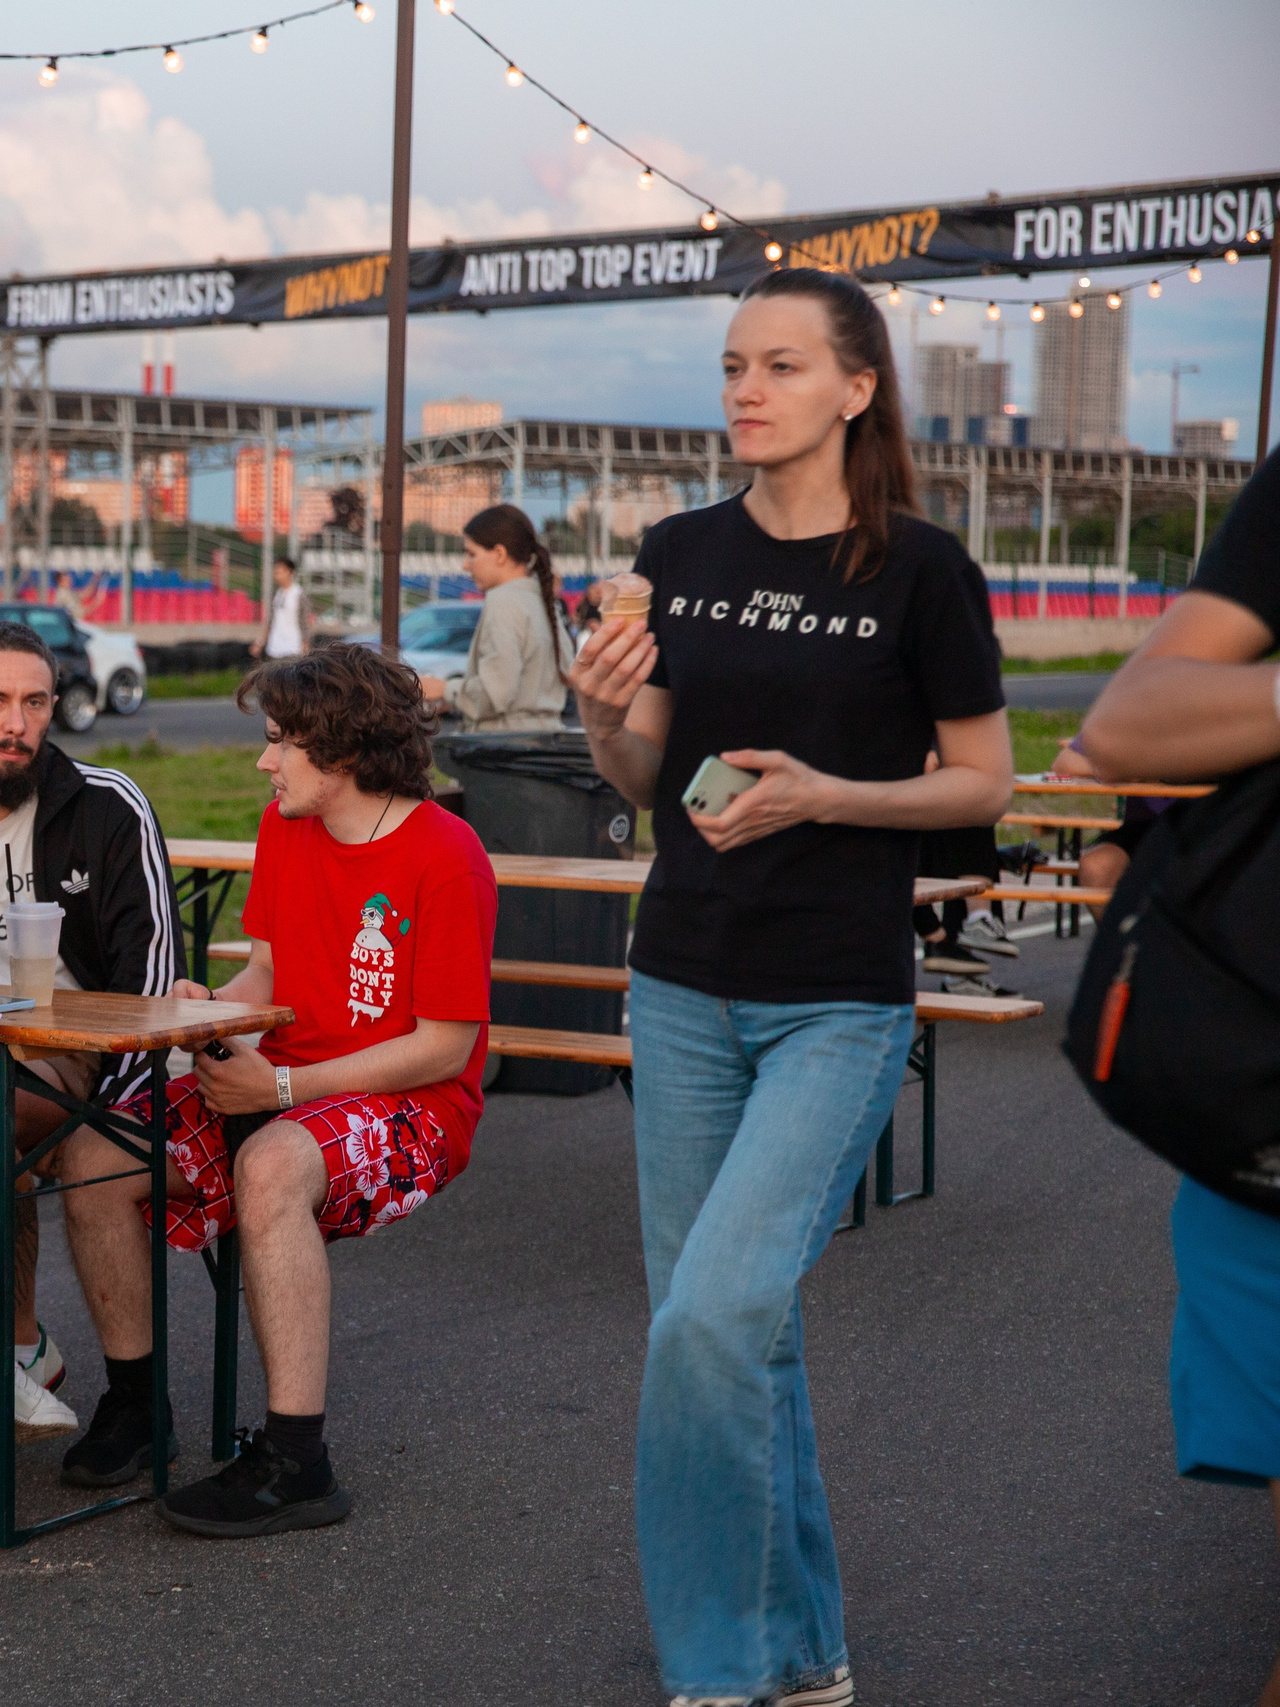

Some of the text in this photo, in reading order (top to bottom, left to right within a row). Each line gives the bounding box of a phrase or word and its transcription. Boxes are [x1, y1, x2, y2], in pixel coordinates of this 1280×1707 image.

[6, 283, 73, 327] FROM
[74, 270, 235, 324] ENTHUSIASTS
[459, 252, 521, 297] ANTI
[524, 247, 577, 292] TOP
[578, 243, 631, 289] TOP
[631, 237, 723, 287] EVENT
[1013, 205, 1083, 260] FOR
[1090, 186, 1280, 255] ENTHUSIA
[748, 589, 805, 612] JOHN
[669, 597, 877, 638] RICHMOND
[349, 982, 393, 1006] CRY
